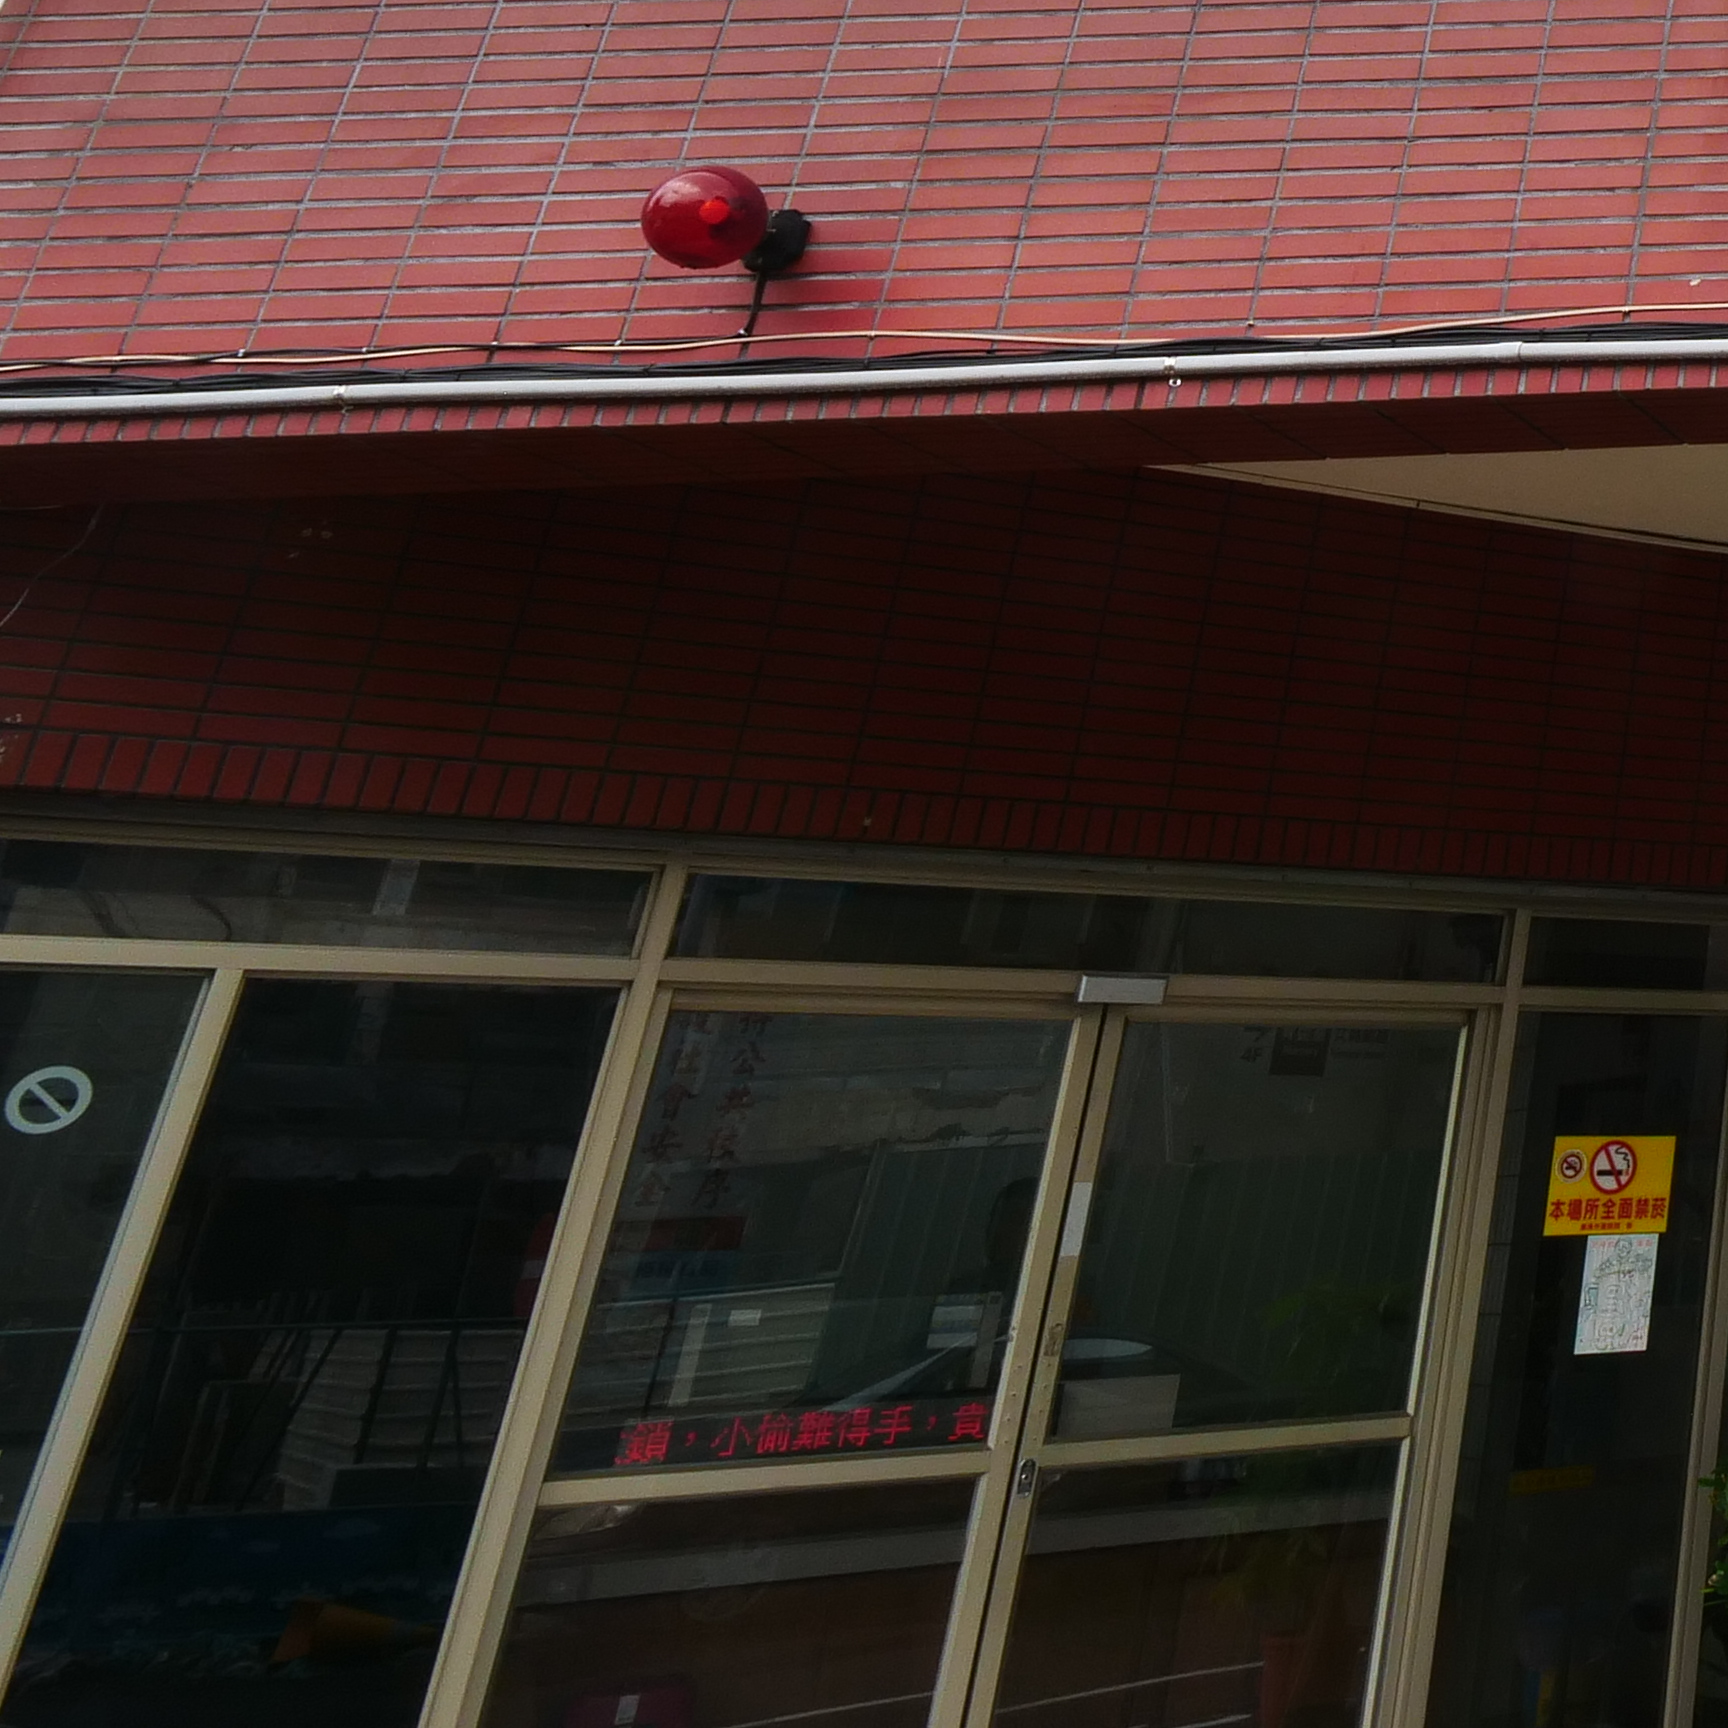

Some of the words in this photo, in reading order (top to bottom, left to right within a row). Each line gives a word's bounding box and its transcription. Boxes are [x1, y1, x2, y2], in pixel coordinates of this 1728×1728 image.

[1549, 1197, 1668, 1222] 本場所全面禁菸
